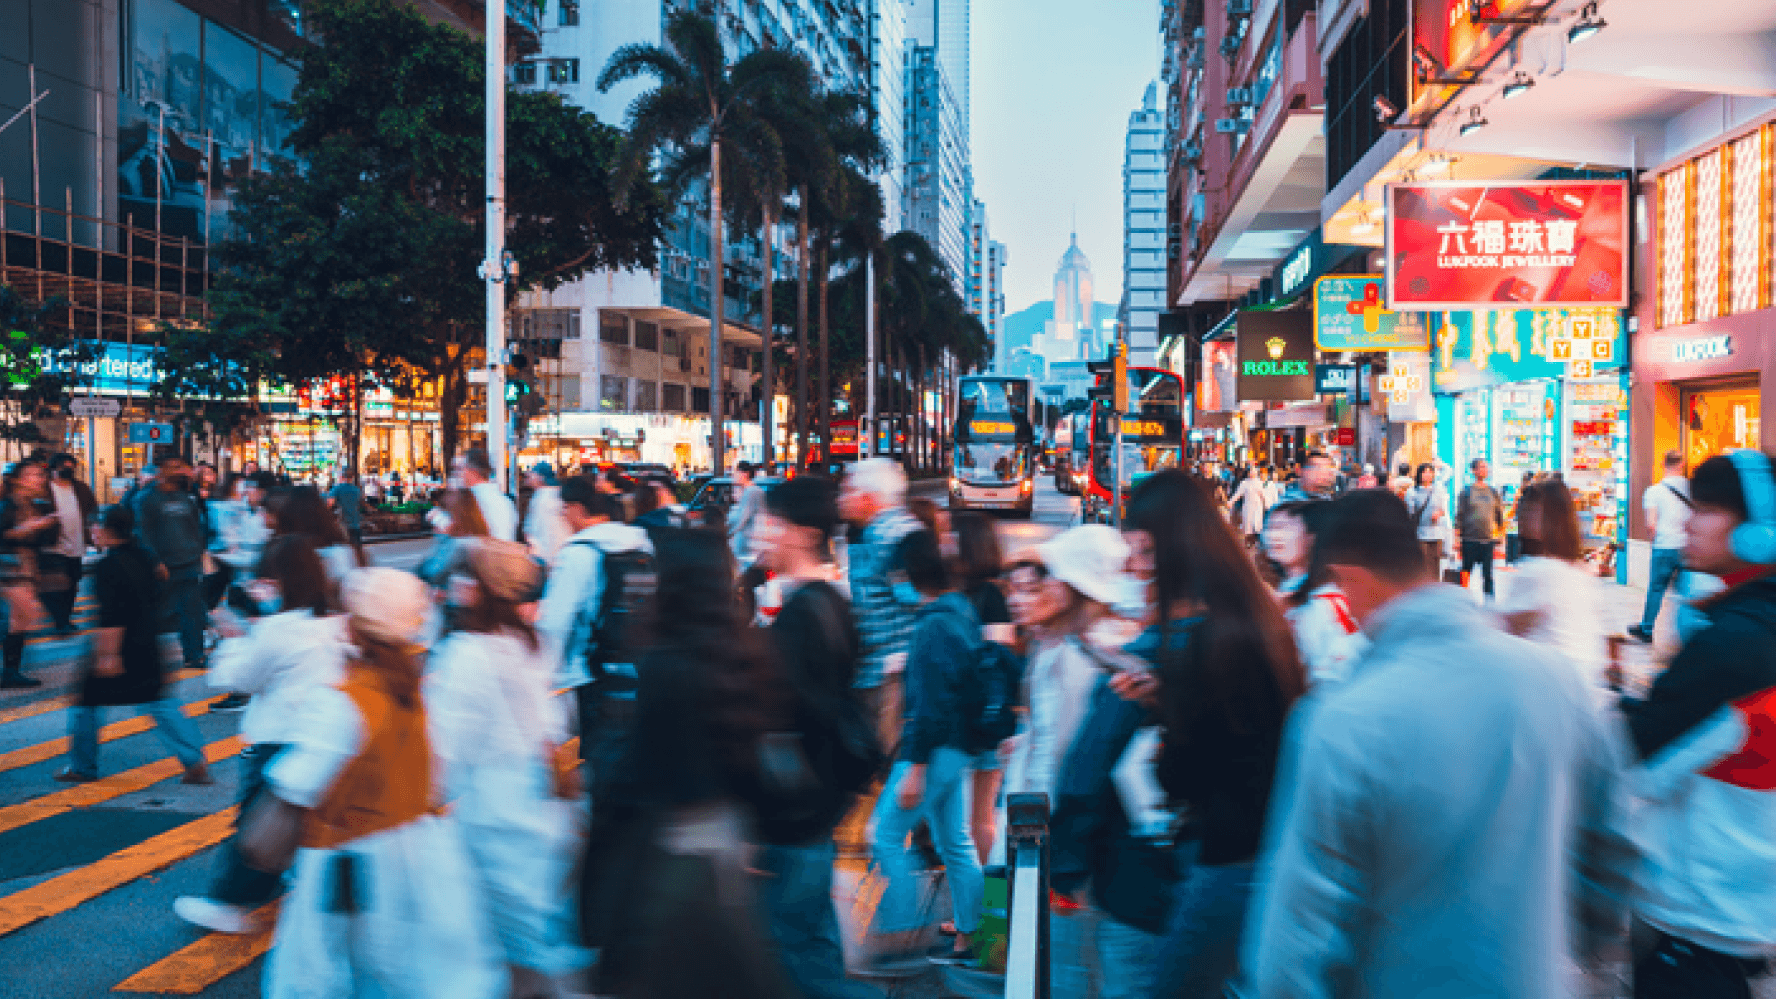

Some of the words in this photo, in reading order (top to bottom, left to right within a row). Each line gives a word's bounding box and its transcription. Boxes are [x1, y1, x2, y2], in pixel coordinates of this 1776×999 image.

[1436, 218, 1578, 254] 六福珠寶
[1241, 359, 1309, 377] ROLEX
